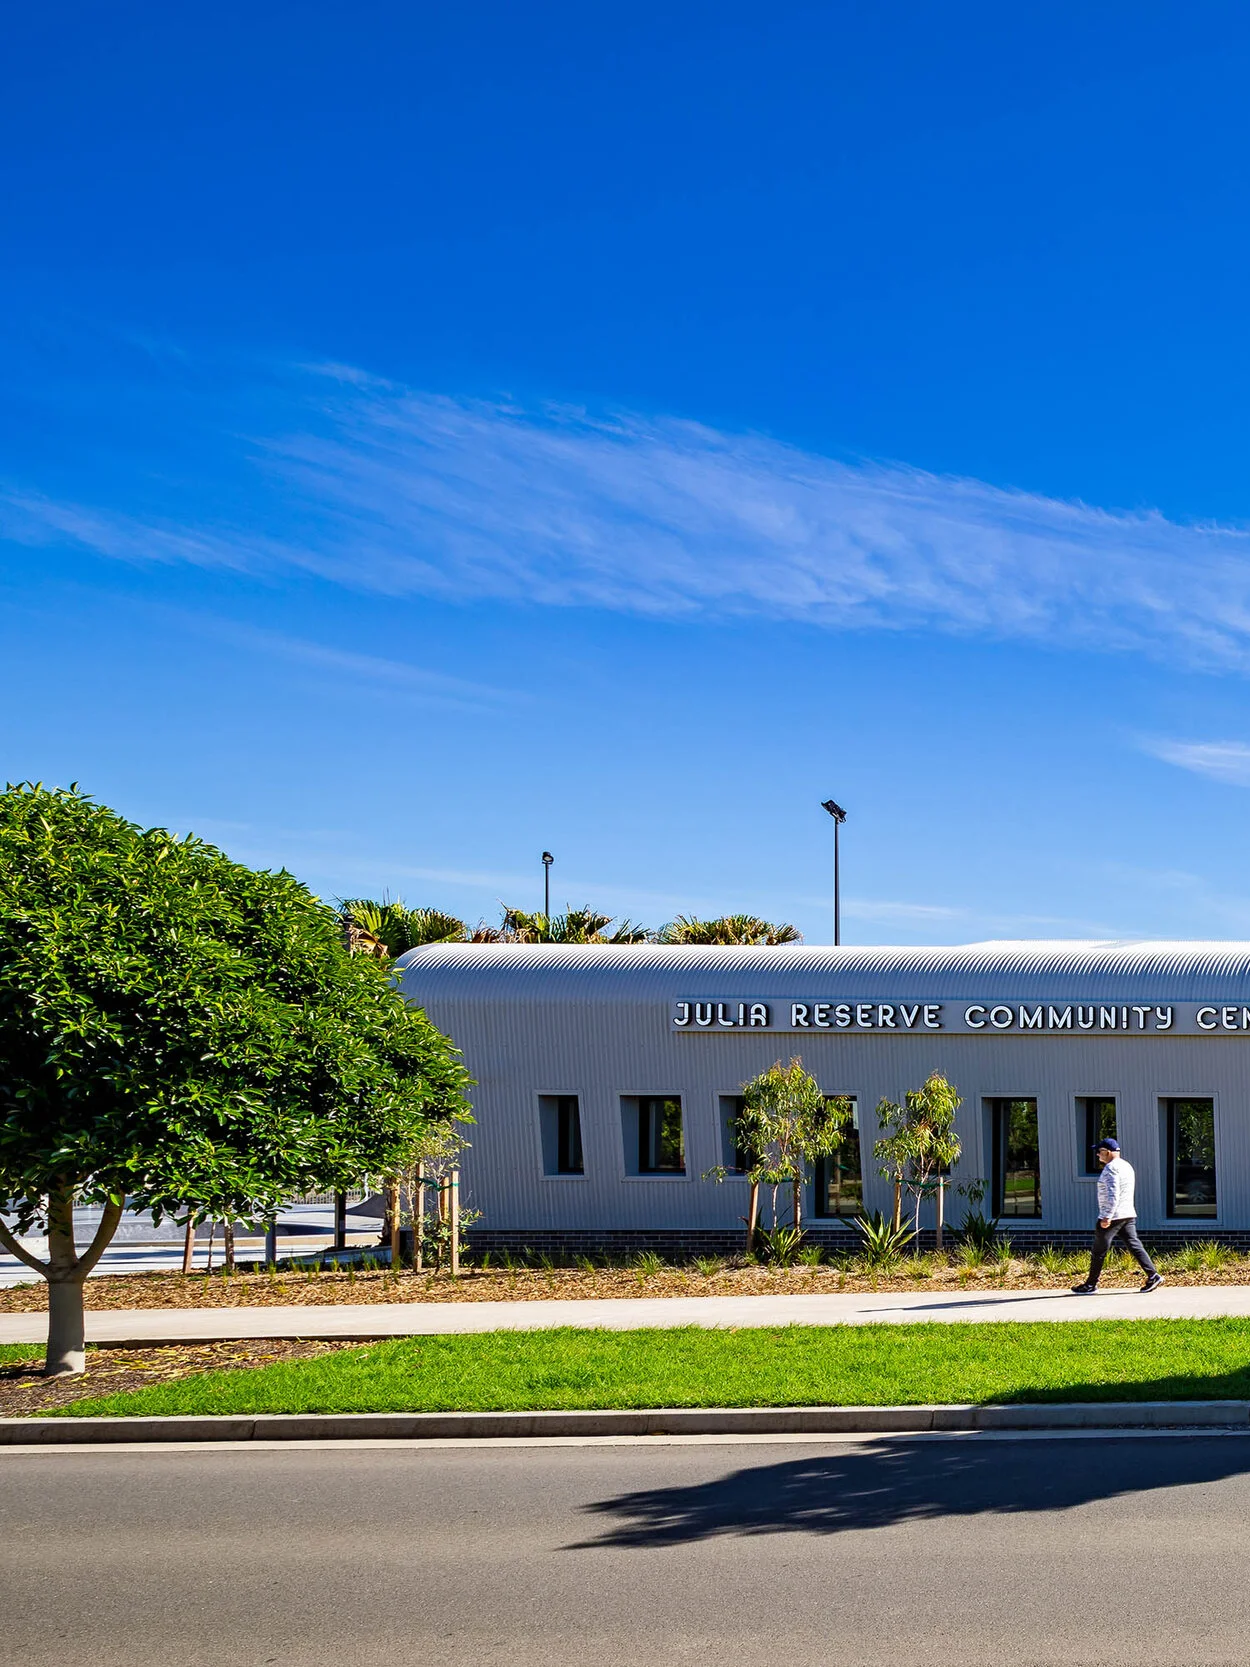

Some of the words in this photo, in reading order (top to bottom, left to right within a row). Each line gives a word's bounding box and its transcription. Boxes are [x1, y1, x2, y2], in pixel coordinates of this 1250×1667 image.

[673, 1002, 769, 1027] JULIA
[791, 1003, 942, 1029] RESERVE
[964, 1004, 1174, 1030] COMMUNITY
